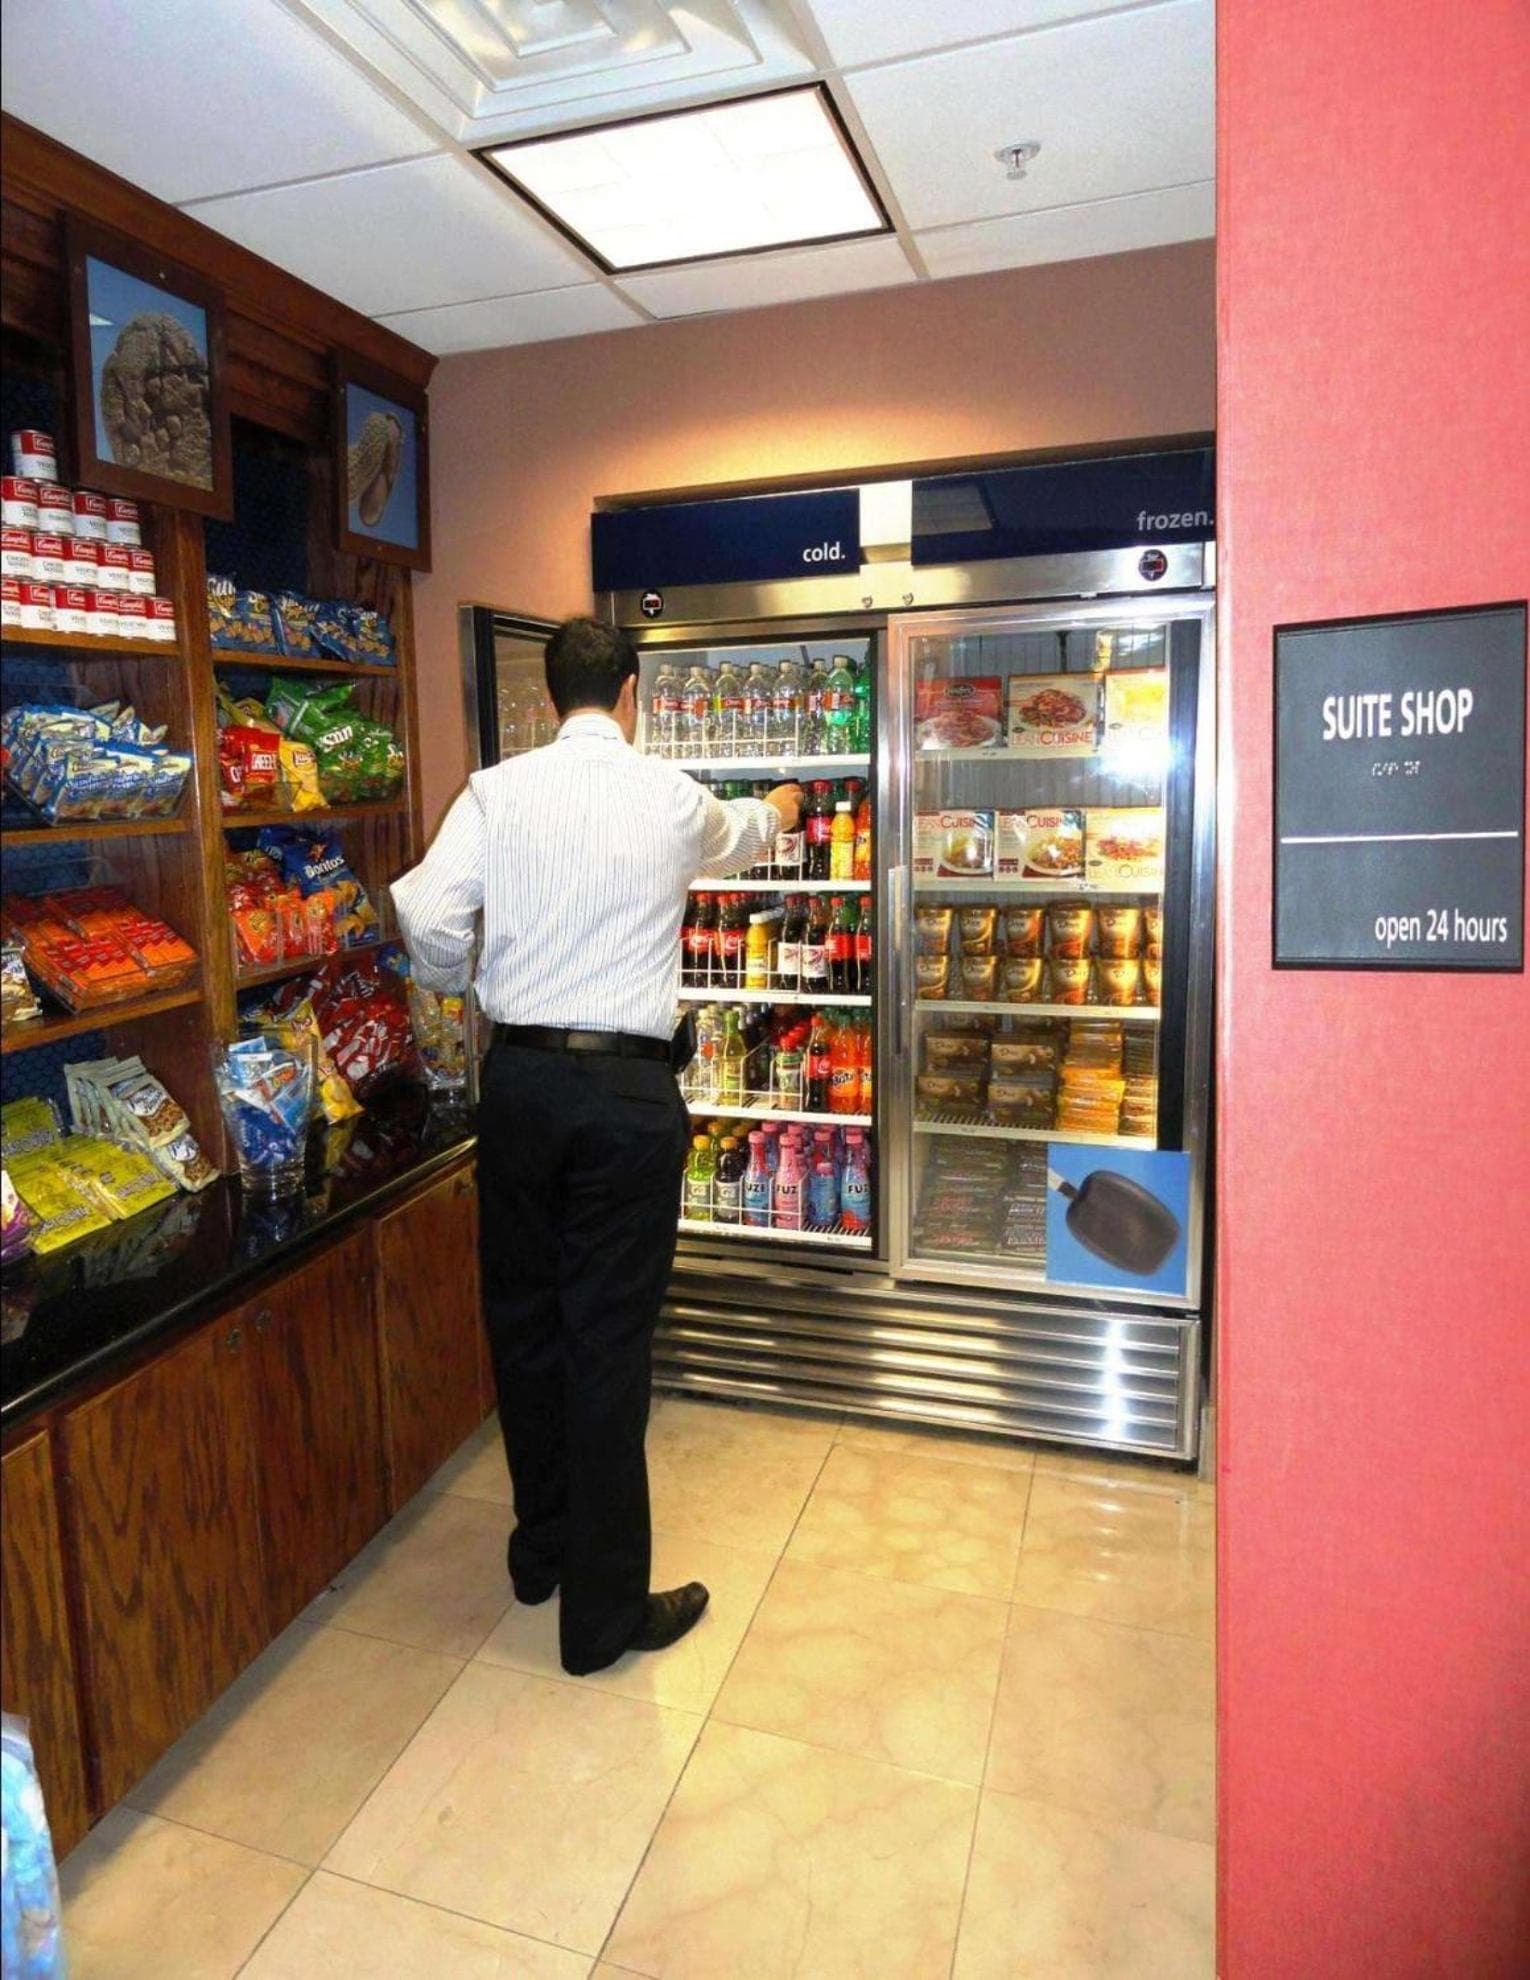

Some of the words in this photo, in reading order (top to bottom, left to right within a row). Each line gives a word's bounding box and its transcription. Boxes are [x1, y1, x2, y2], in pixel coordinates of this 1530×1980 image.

[1137, 507, 1214, 531] frozen.
[802, 541, 845, 562] cold.
[1322, 693, 1392, 740] SUITE
[1401, 688, 1473, 737] SHOP
[302, 856, 344, 879] Doritos
[1375, 914, 1420, 948] open
[1426, 908, 1448, 943] 24
[1454, 908, 1507, 943] hours
[776, 1184, 797, 1194] FUZ
